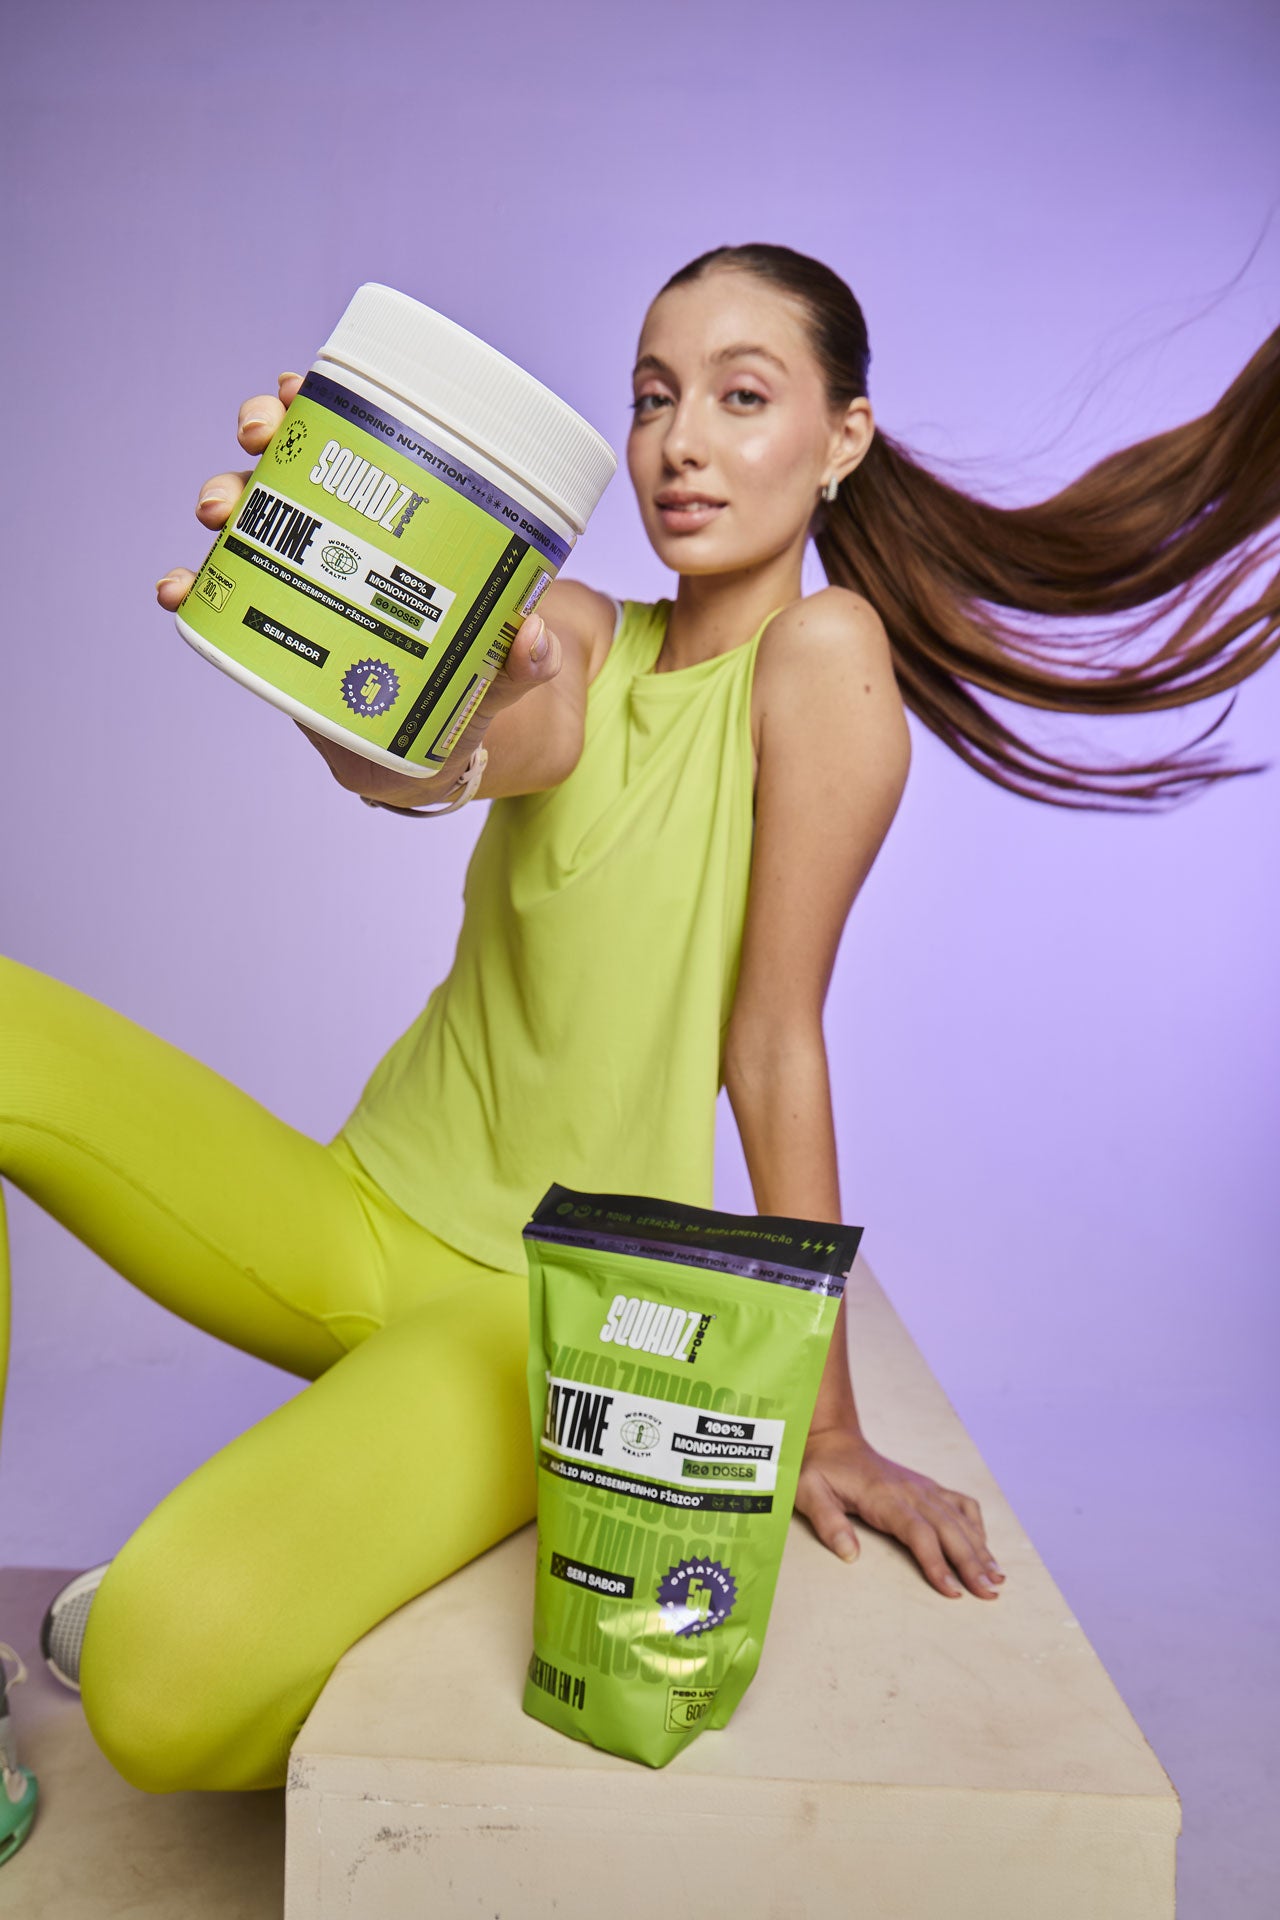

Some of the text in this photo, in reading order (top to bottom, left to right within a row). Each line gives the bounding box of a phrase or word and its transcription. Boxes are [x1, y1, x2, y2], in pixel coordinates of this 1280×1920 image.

[334, 395, 349, 409] NO
[350, 402, 395, 437] BORING
[309, 440, 413, 533] SQUADZ
[236, 487, 323, 566] CREATINE
[502, 506, 519, 522] NO
[519, 519, 551, 547] BORING
[328, 539, 362, 561] WORKOUT
[251, 554, 280, 574] AUXÍLIO
[279, 570, 292, 581] NO
[291, 577, 345, 612] DESEMPENHO
[320, 563, 347, 581] HEALTH
[399, 572, 427, 594] 100%
[369, 574, 439, 619] MONOHYDRATE
[375, 597, 420, 627] 60 DOSES
[263, 623, 320, 661] SEM SABOR
[356, 665, 394, 692] CREATINA
[420, 690, 435, 710] NOVA
[455, 641, 464, 652] DA
[347, 684, 385, 712] POR DOSE
[758, 1269, 775, 1278] NO
[776, 1273, 816, 1287] BORING
[599, 1294, 703, 1362] SQUADZ
[625, 1412, 662, 1426] WORKOUT
[705, 1421, 745, 1437] 100%
[622, 1446, 651, 1457] HEALTH
[674, 1436, 770, 1458] MONOHYDRATE
[579, 1469, 594, 1482] NO
[595, 1474, 659, 1499] DESEMPENHO
[685, 1464, 754, 1479] 120 DOSES
[566, 1566, 626, 1594] SEM SABOR
[558, 1671, 572, 1705] EM
[572, 1676, 586, 1711] PÓ
[672, 1690, 697, 1698] PESO
